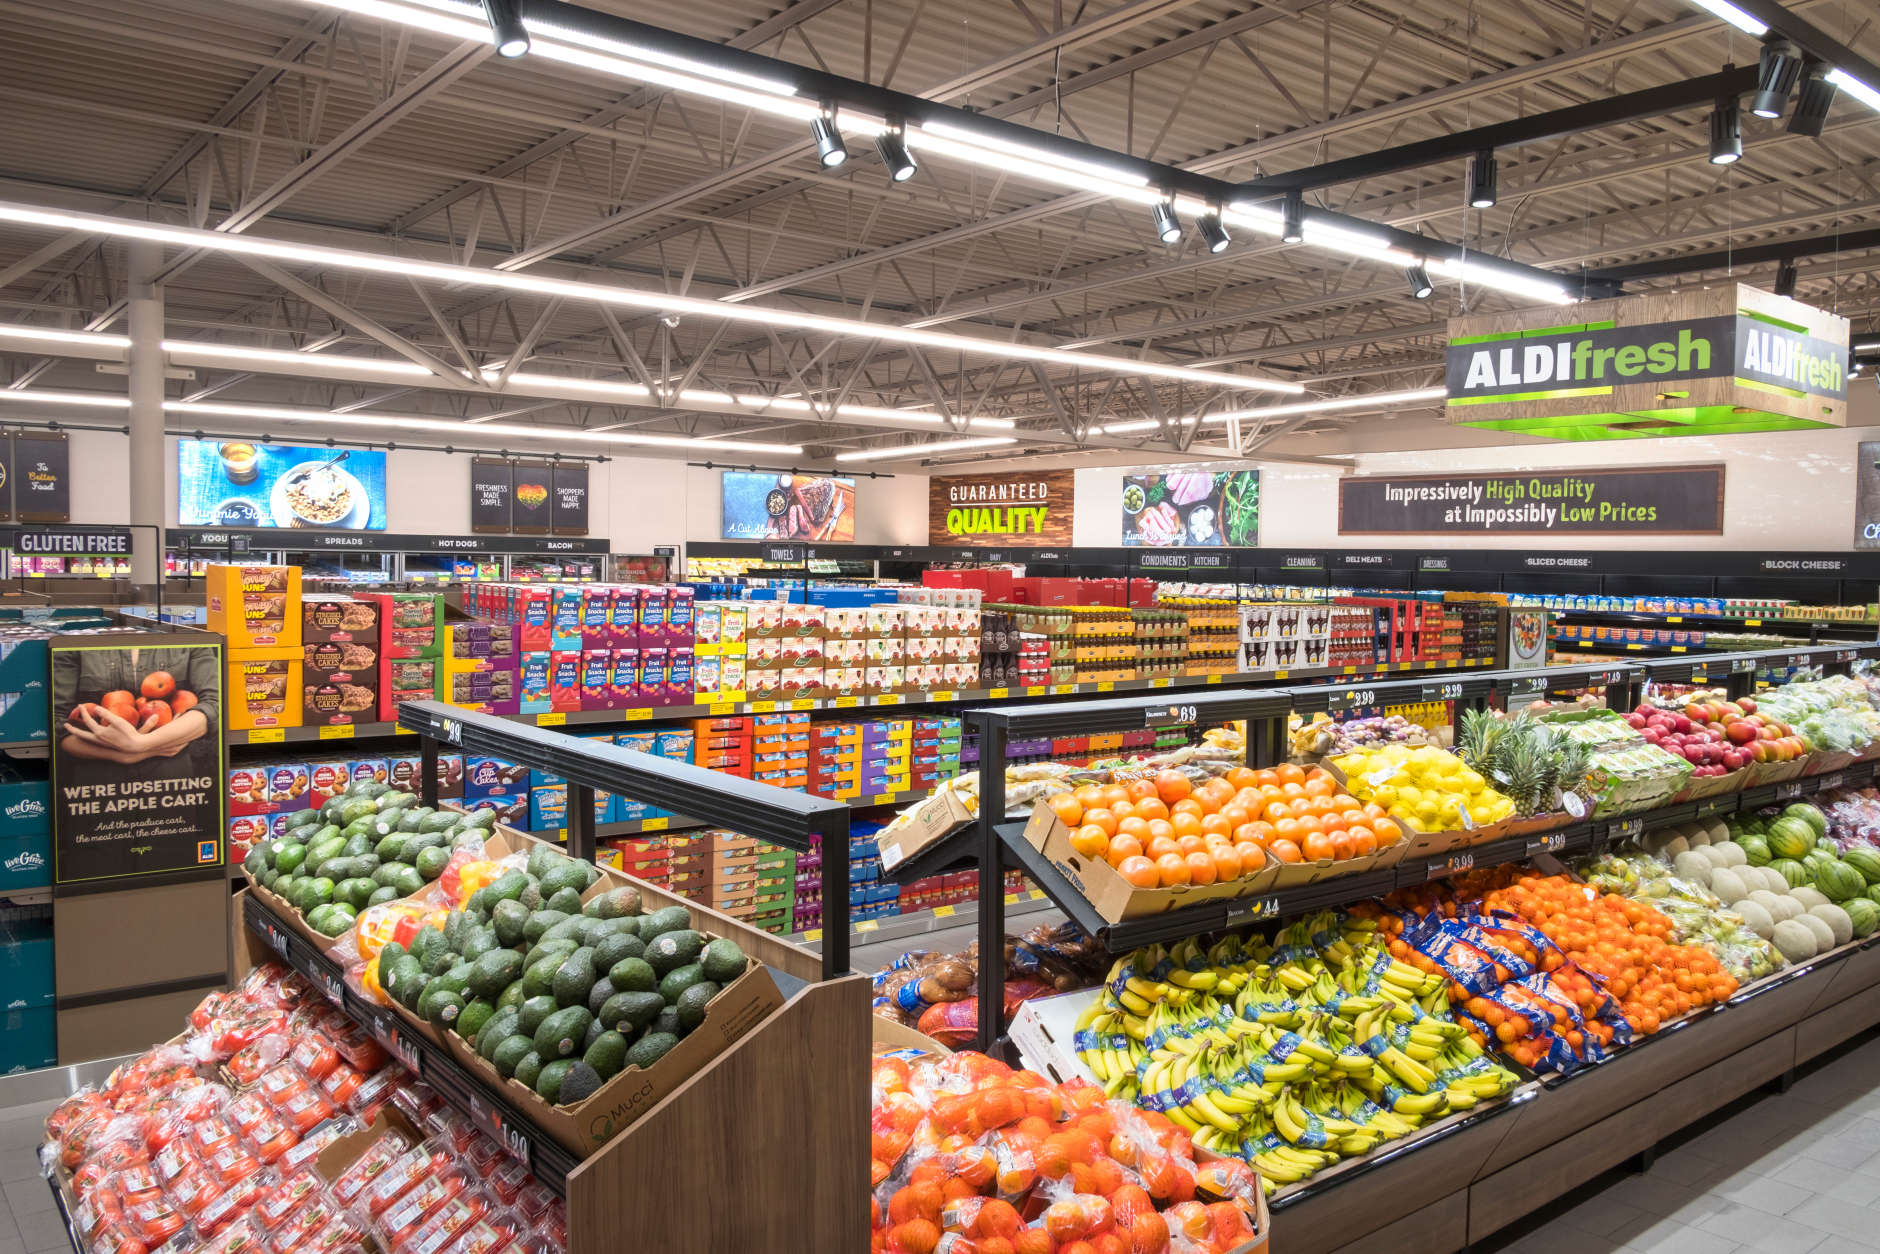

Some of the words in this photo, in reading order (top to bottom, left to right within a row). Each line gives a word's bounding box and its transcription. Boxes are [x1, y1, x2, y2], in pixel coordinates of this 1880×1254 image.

[1464, 328, 1711, 389] ALDIfresh
[1743, 328, 1843, 393] ALDIfresh
[36, 462, 49, 472] To
[31, 481, 55, 491] Food
[475, 483, 508, 493] FRESHNESS
[556, 487, 585, 497] SHOPPERS
[950, 482, 1048, 501] GUARANTEED
[1385, 481, 1483, 506] Impressively
[1486, 480, 1525, 505] High
[1529, 478, 1595, 503] Quality
[483, 492, 500, 500] MADE
[563, 495, 579, 503] MADE
[1445, 504, 1462, 523] at
[1465, 503, 1557, 528] Impossibly
[1560, 503, 1595, 522] Low
[1600, 501, 1657, 522] Prices
[946, 506, 1049, 536] QUALITY
[737, 522, 751, 534] Cut
[21, 534, 84, 552] GLUTEN
[87, 535, 126, 552] FREE
[325, 537, 363, 545] SPREADS
[438, 540, 454, 548] HOT
[456, 540, 477, 548] DOGS
[771, 549, 794, 561] TOWELS
[1141, 555, 1187, 567] CONDIMENTS
[1194, 556, 1220, 566] KITCHEN
[1287, 557, 1317, 567] CLEANING
[1423, 559, 1448, 568] DRESSINGS
[1527, 557, 1556, 566] SLICED
[1557, 557, 1588, 566] CHEESE
[1765, 560, 1799, 570] BLOCK
[1801, 560, 1841, 570] CHEESE
[64, 783, 116, 800] WE'RE
[121, 776, 213, 795] UPSETTING
[68, 801, 101, 816] THE
[104, 796, 158, 813] APPLE
[161, 792, 209, 808] CART.
[94, 821, 115, 832] And
[116, 820, 130, 830] the
[130, 818, 164, 830] produce
[75, 832, 90, 843] the
[91, 831, 112, 842] meat
[136, 828, 150, 839] the
[150, 826, 178, 837] cheese
[611, 1079, 654, 1121] Mucci
